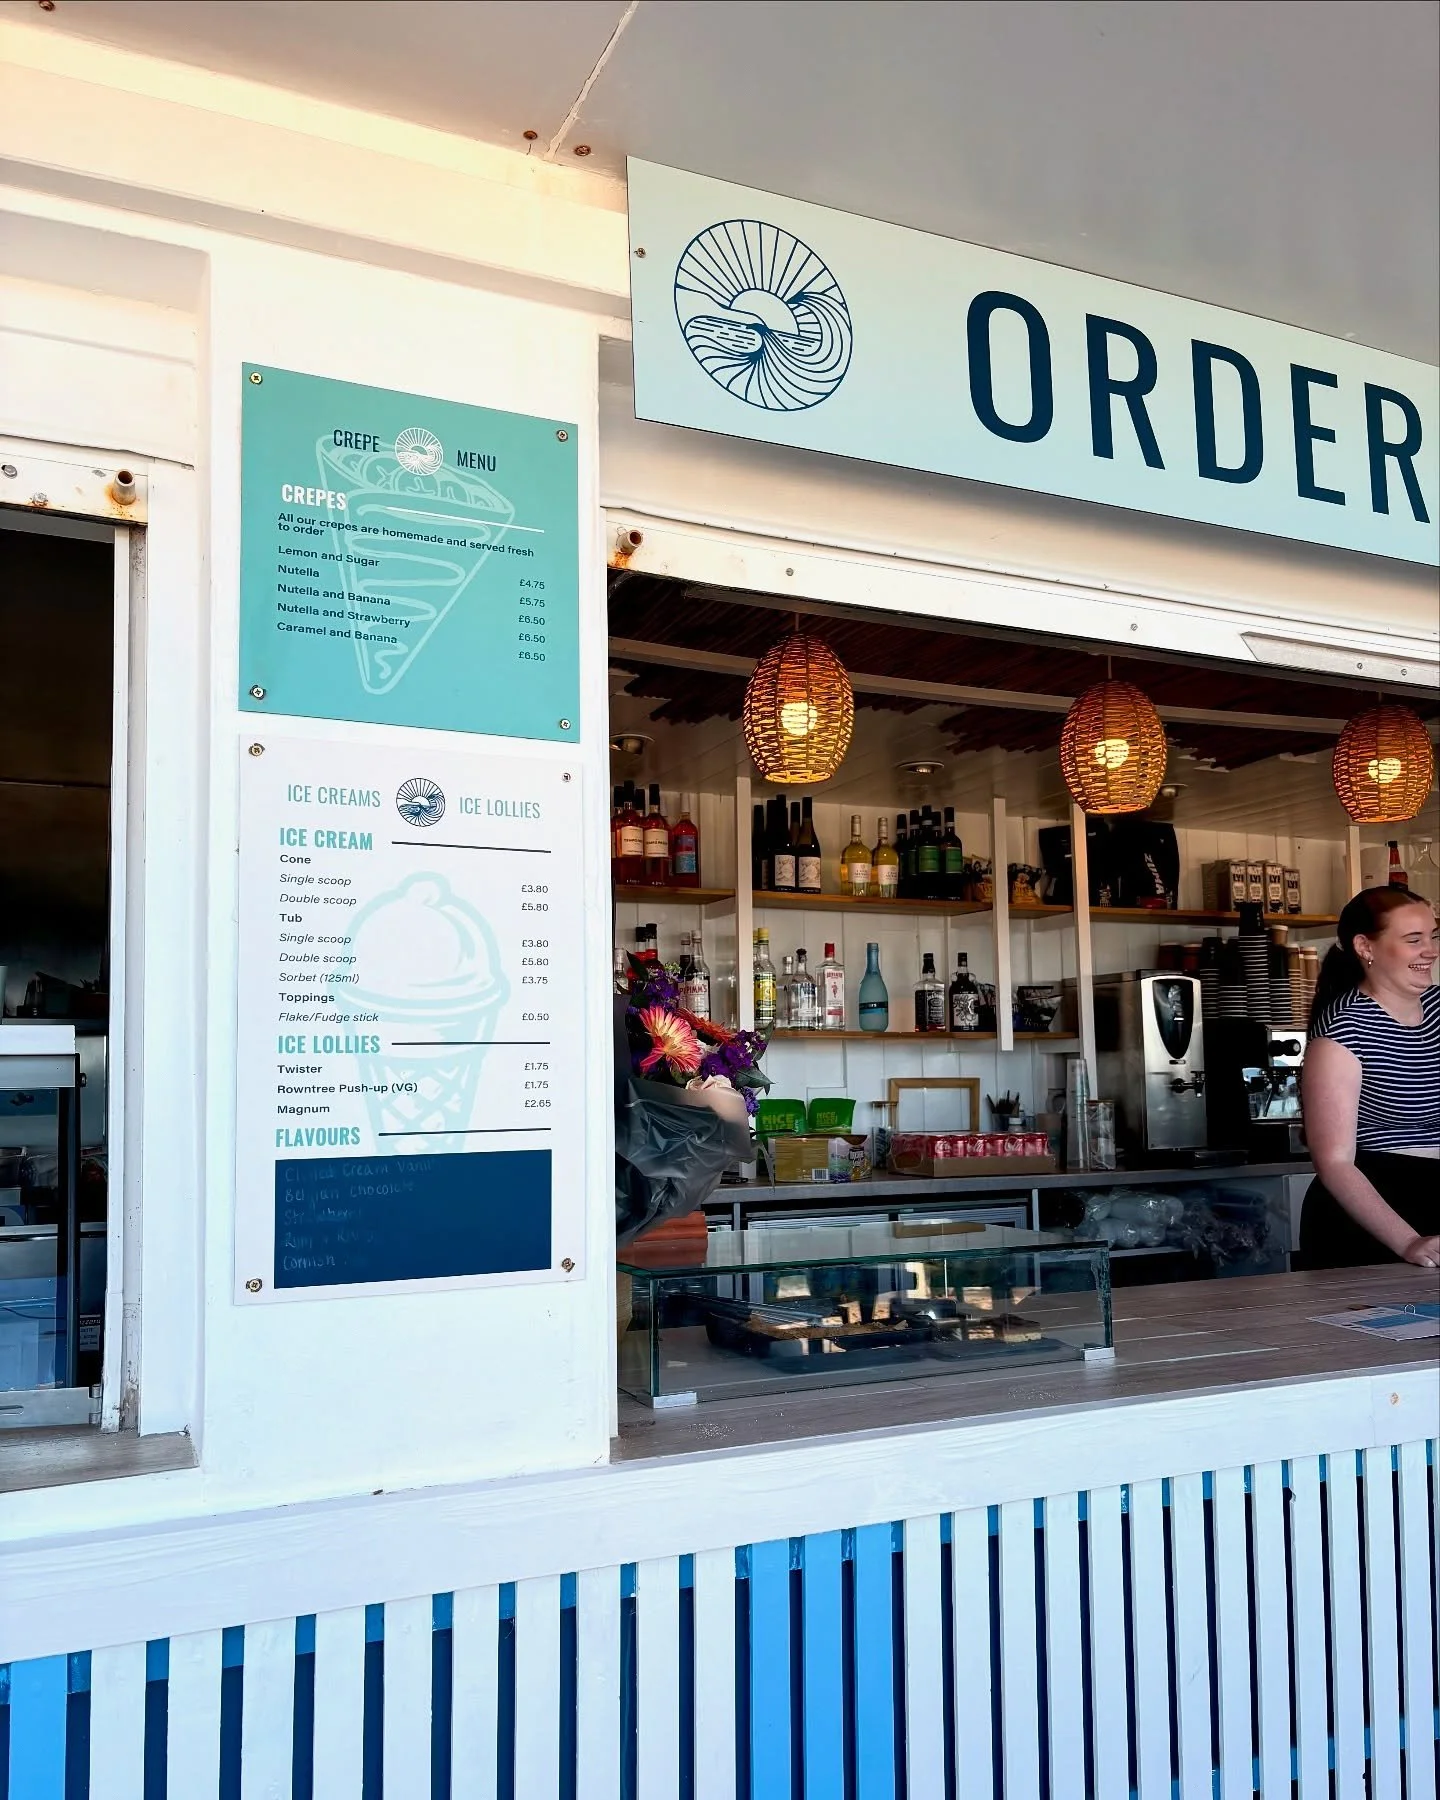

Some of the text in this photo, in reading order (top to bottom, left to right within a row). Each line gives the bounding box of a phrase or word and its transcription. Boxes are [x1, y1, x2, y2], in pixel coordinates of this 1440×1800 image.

[967, 290, 1430, 524] ORDER
[333, 429, 496, 472] CREPE MENU
[282, 484, 348, 511] CREPES
[277, 522, 325, 536] to order
[278, 512, 534, 557] All our crepes are homemade and served fresh
[278, 545, 545, 590] Lemon and Sugar £4.75
[278, 564, 546, 608] Nutella £5.75
[277, 583, 546, 626] Nutella and Banana £6.50
[277, 602, 546, 644] Nutella and Strawberry £6.50
[276, 621, 546, 662] Caramel and Banana £6.50
[288, 784, 381, 808] ICE CREAMS
[460, 797, 541, 819] ICE LOLLIES
[280, 827, 373, 851] ICE CREAM
[279, 854, 312, 864] Cone
[279, 873, 549, 894] Single scoop £3.80
[1144, 852, 1165, 895] ZUMA
[279, 893, 549, 912] Double scoop £5.80
[279, 913, 303, 923] Tub
[279, 933, 549, 948] Single scoop £3.80
[279, 952, 549, 966] Double scoop £5.80
[278, 972, 549, 985] Sorbet (125ml) £3.75
[278, 992, 335, 1004] Toppings
[278, 1012, 550, 1024] Flake/Fudge stick £0.50
[278, 1035, 380, 1054] ICE LOLLIES
[277, 1062, 549, 1074] Twister £1.75
[277, 1080, 549, 1094] Rowntree Push-up (VG) £1.75
[277, 1099, 552, 1116] Magnum £2.65
[762, 1113, 795, 1125] NICE
[275, 1126, 361, 1148] FLAVOURS
